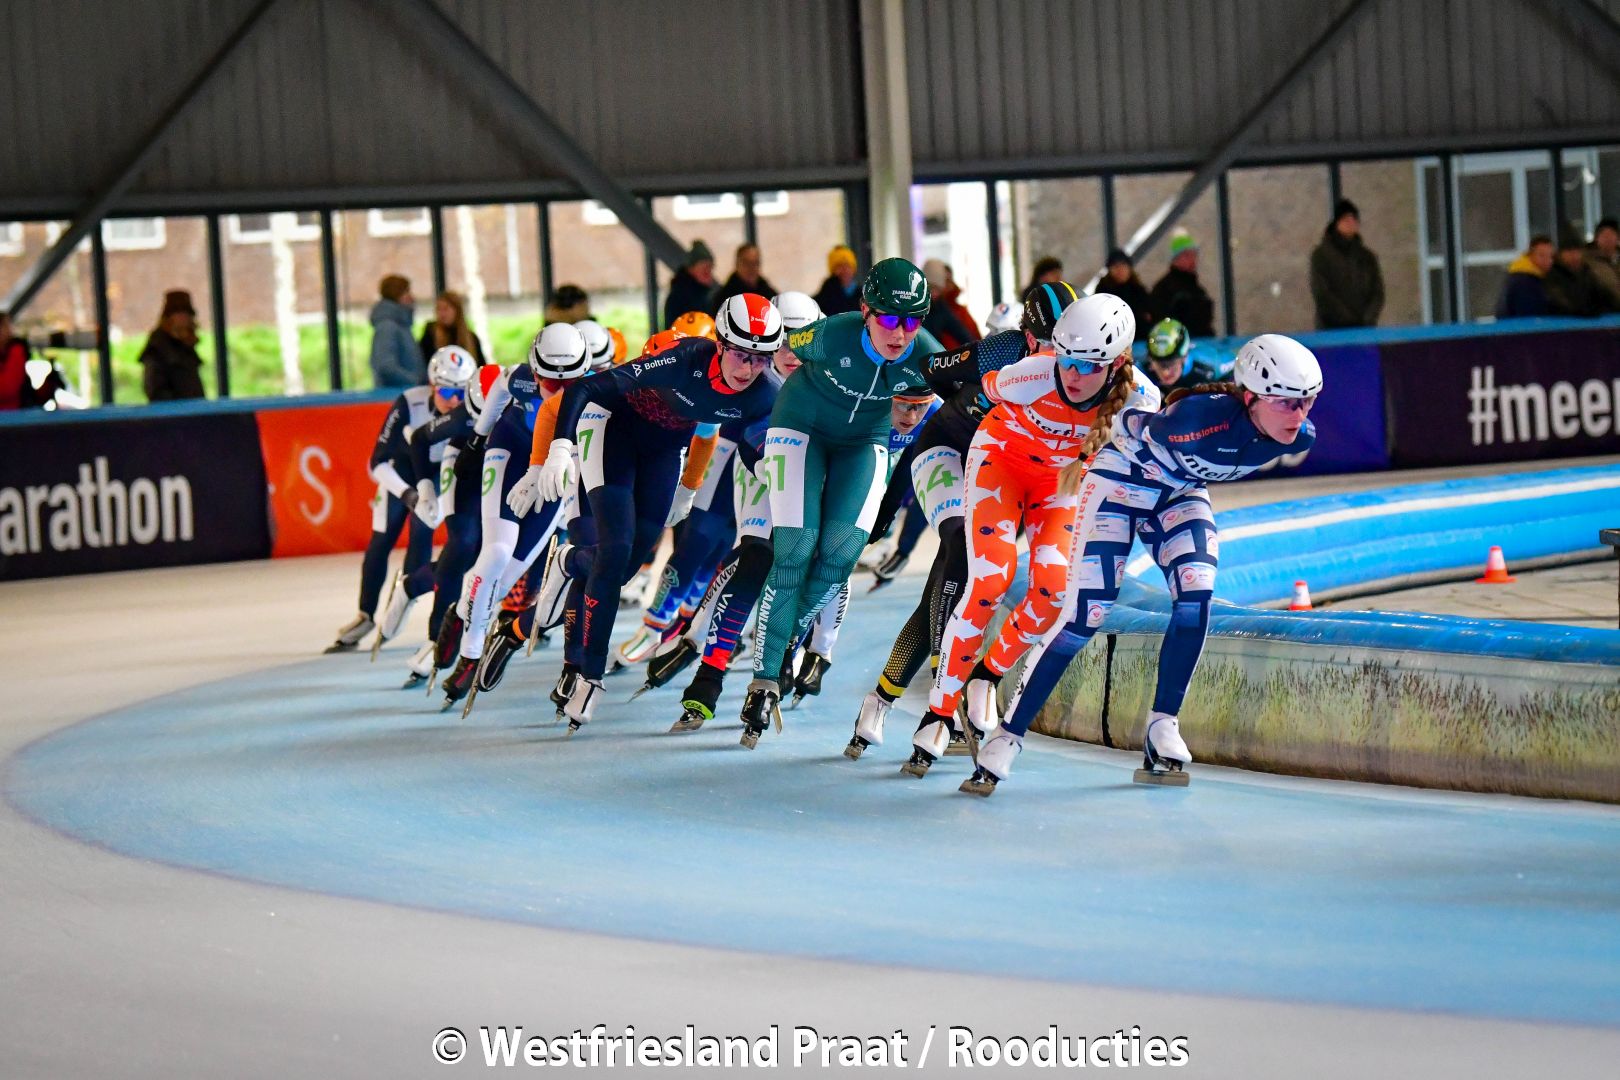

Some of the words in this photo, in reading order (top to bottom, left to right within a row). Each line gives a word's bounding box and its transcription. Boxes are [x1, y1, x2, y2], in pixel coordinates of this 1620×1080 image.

[644, 355, 677, 371] Boltrics
[934, 353, 961, 370] PUUR
[1167, 420, 1230, 443] staatsloterij
[0, 456, 194, 557] arathon
[755, 584, 777, 659] ZAANLANDER
